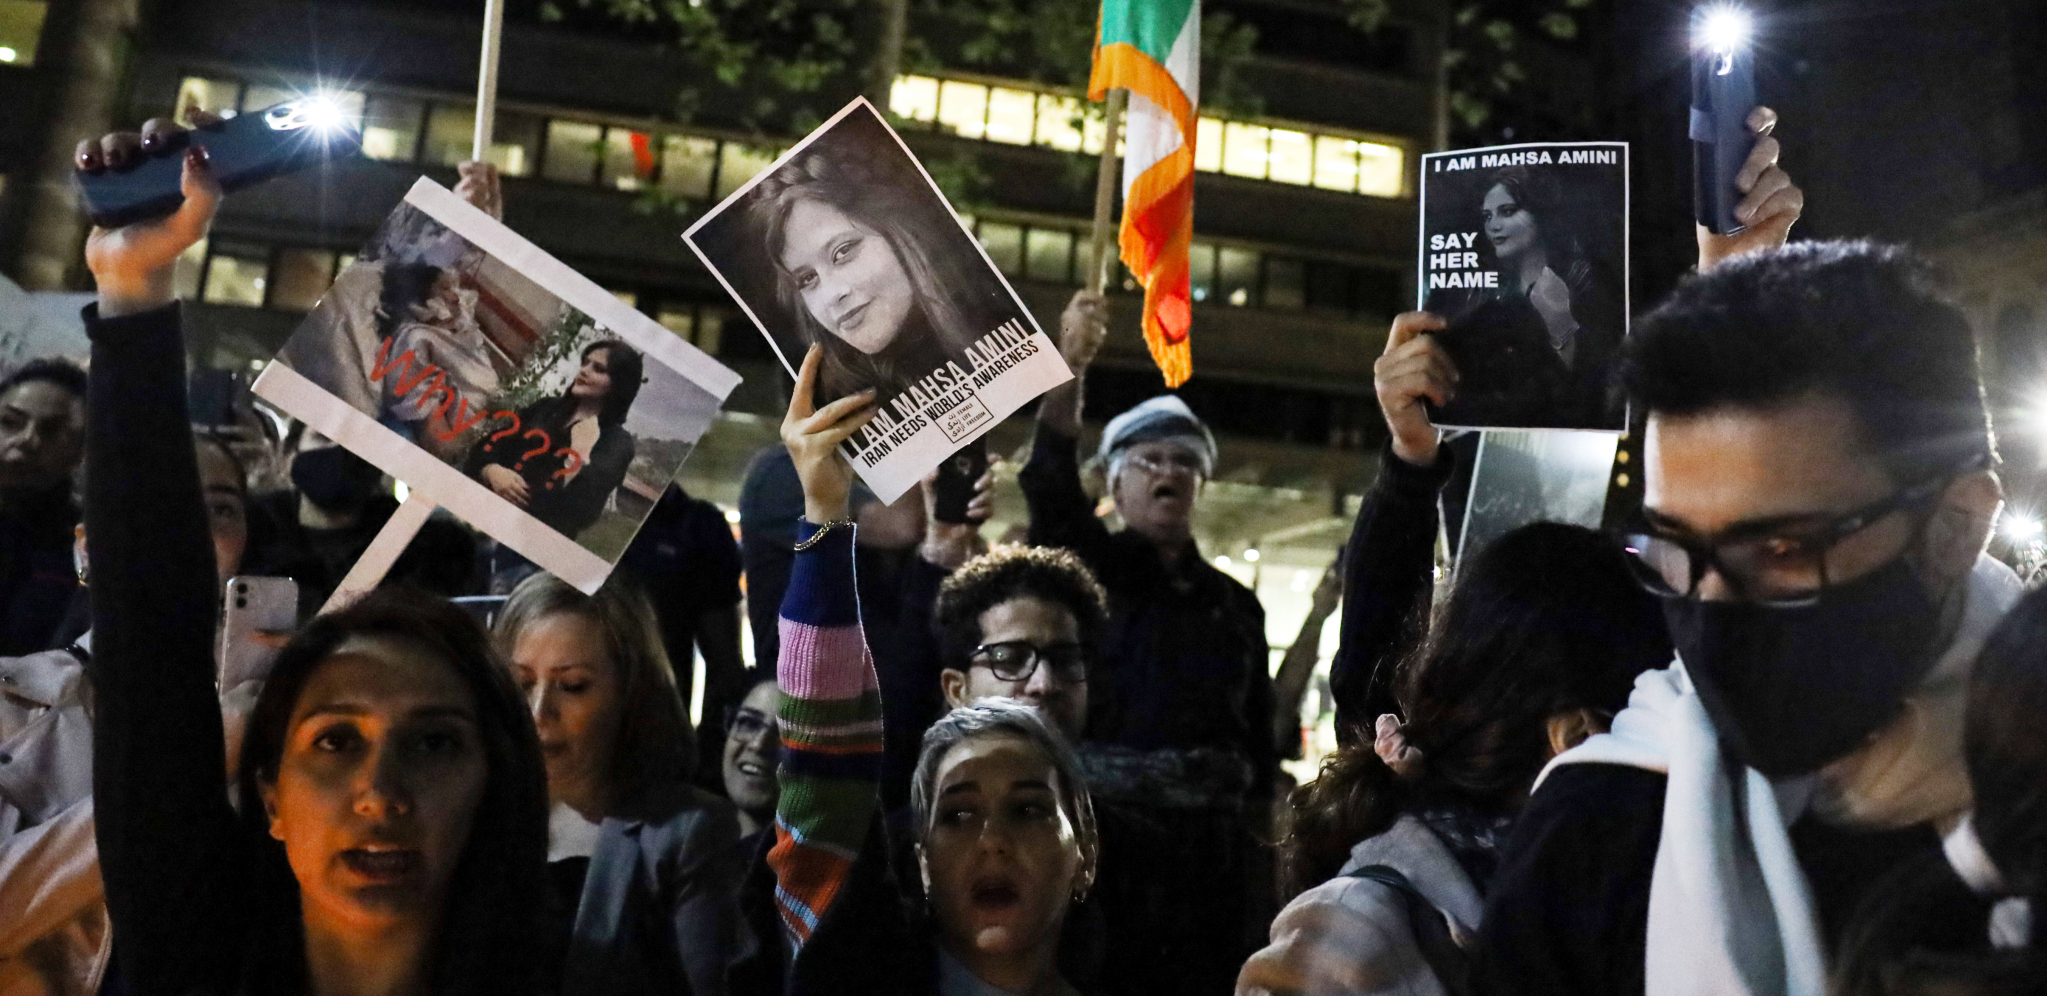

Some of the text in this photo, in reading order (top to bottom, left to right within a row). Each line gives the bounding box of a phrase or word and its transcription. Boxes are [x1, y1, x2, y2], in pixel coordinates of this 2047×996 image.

[1435, 150, 1617, 172] I AM MAHSA AMINI
[1430, 232, 1478, 250] SAY
[1430, 251, 1479, 270] HER
[1429, 271, 1499, 289] NAME
[860, 407, 900, 447] AM
[890, 360, 970, 422] MAHSA
[964, 317, 1033, 373] AMINI
[861, 339, 1040, 468] IRAN NEEDS WORLD'S AWARENESS
